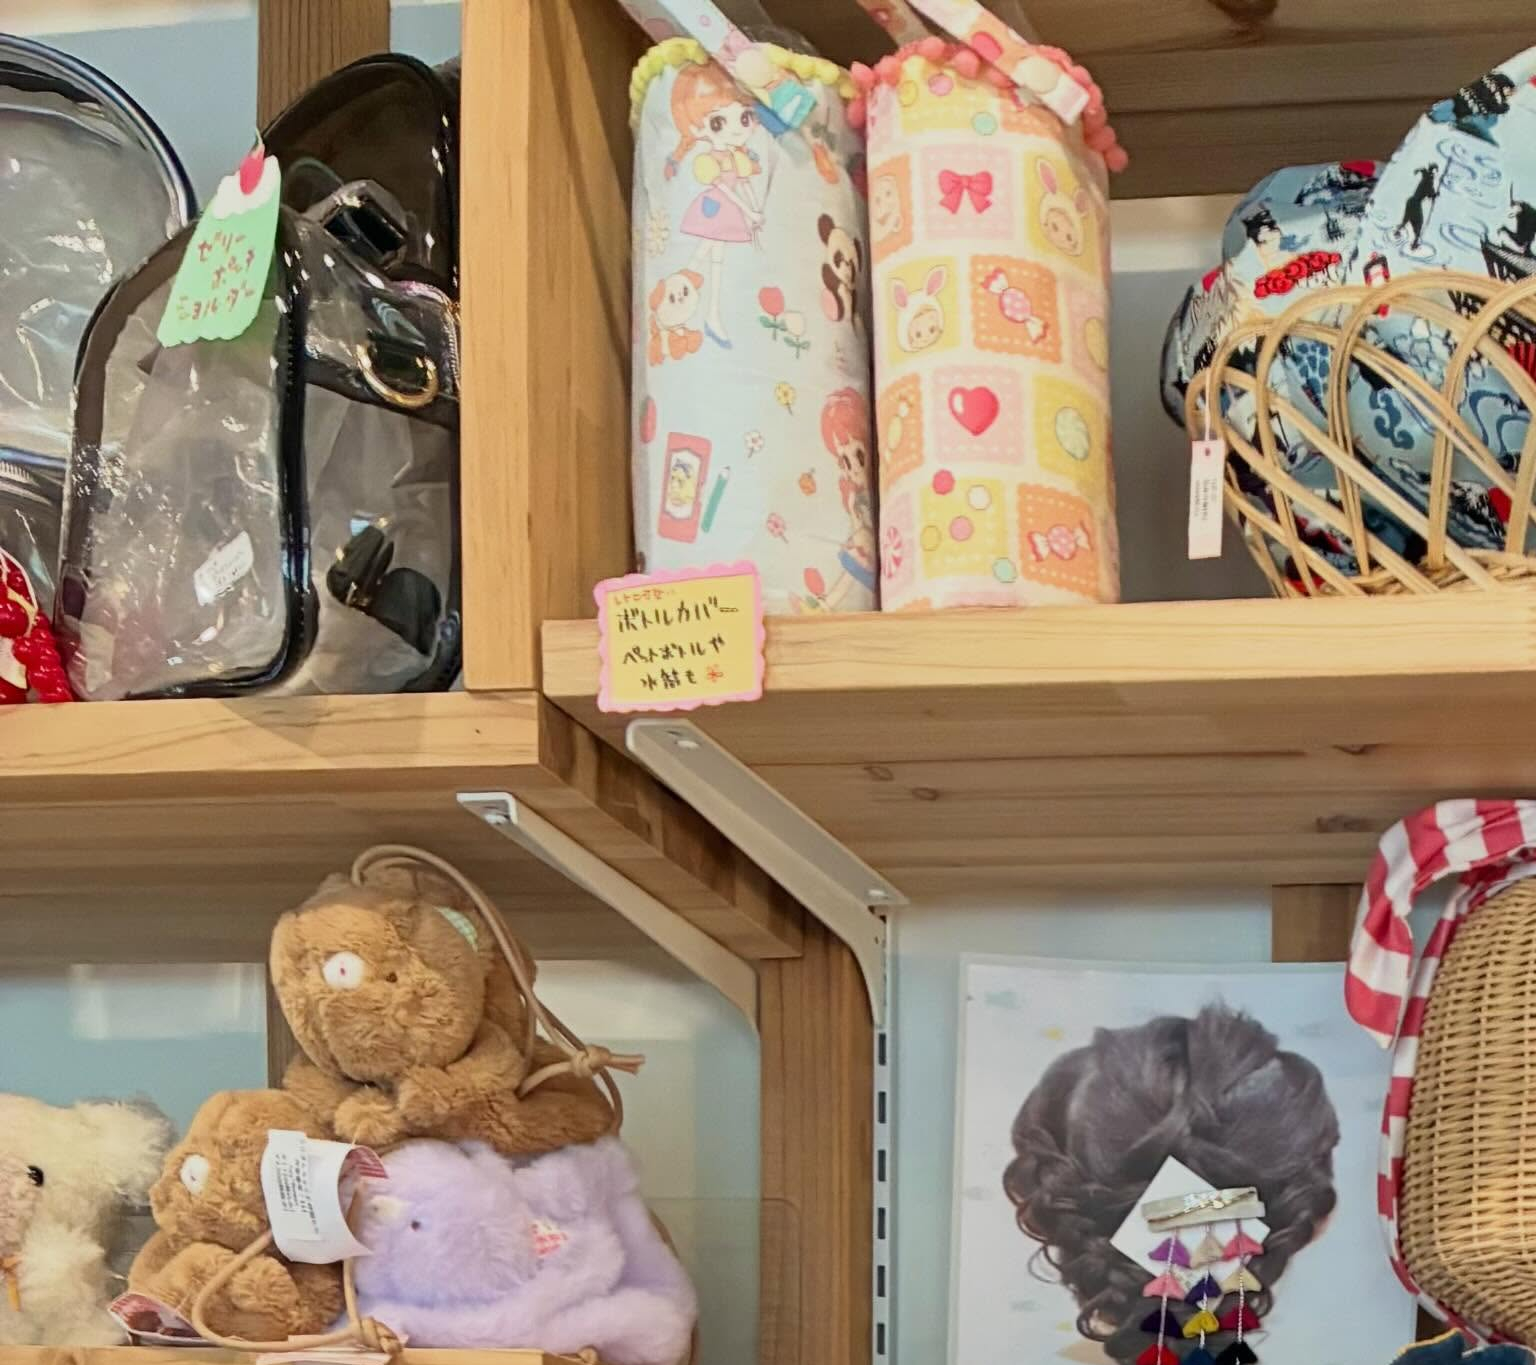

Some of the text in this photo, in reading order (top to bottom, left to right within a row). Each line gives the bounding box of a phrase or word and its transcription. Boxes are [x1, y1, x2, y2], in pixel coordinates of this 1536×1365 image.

[617, 596, 739, 632] ボトルカバー
